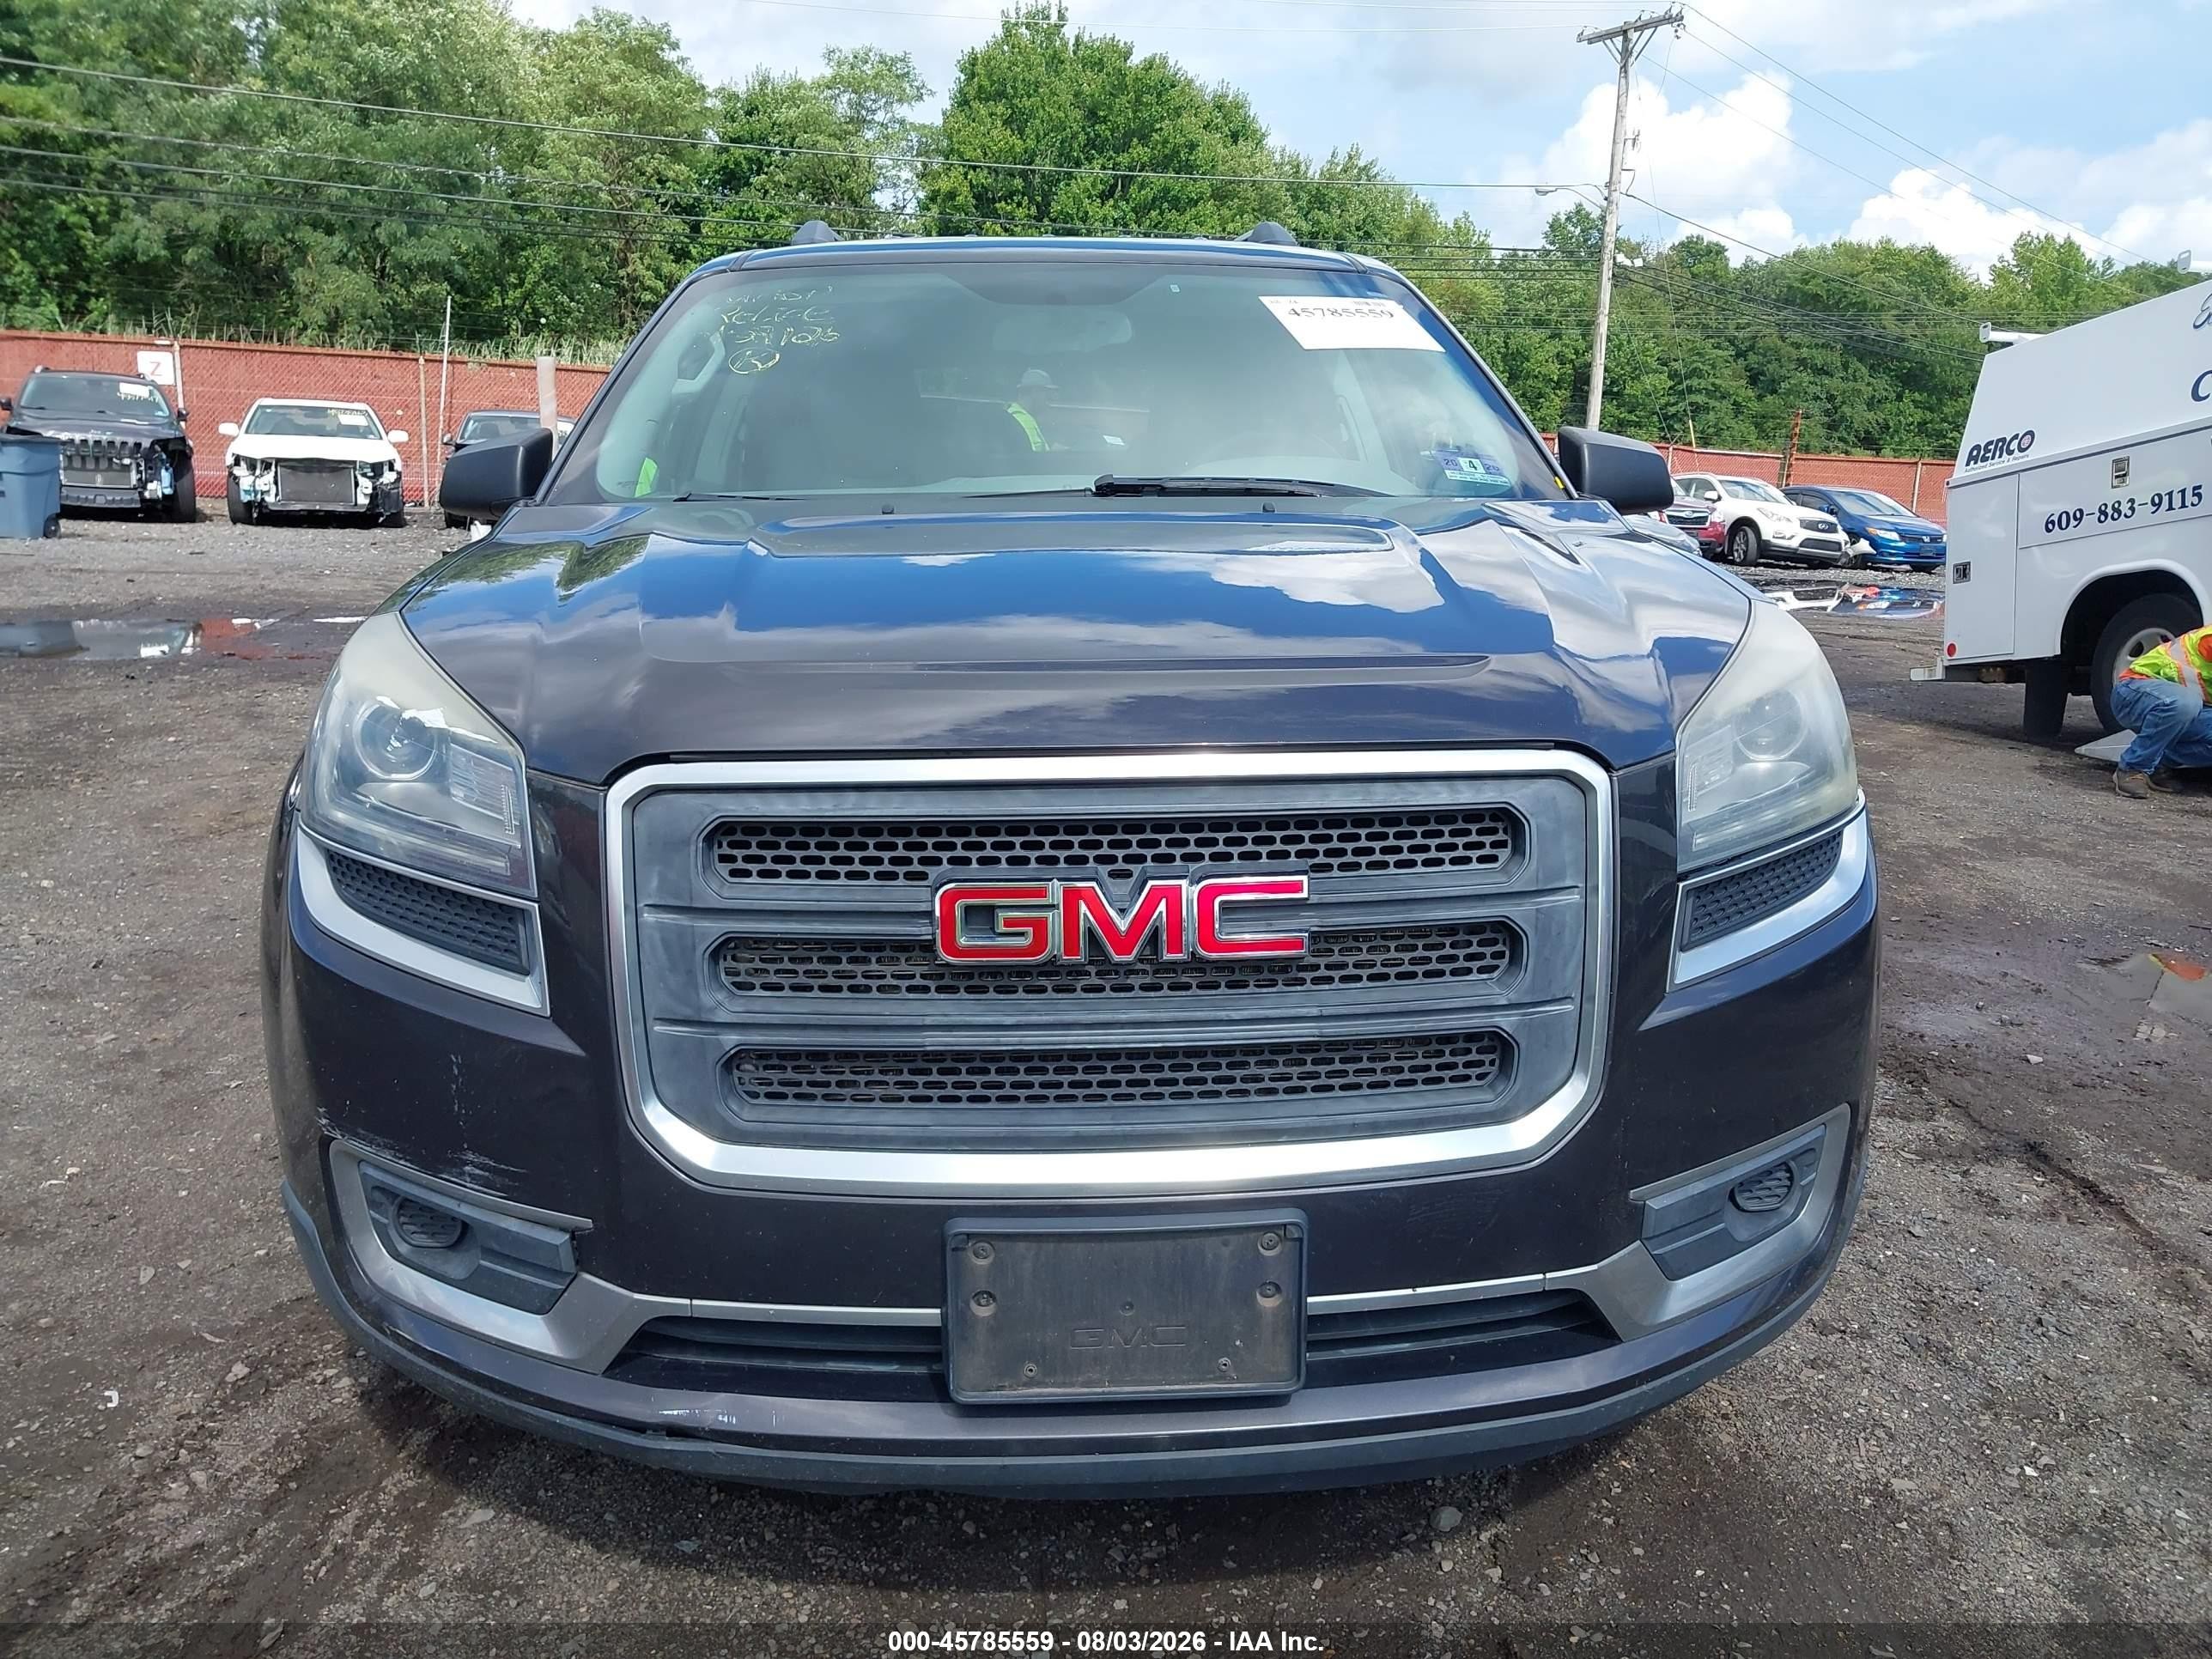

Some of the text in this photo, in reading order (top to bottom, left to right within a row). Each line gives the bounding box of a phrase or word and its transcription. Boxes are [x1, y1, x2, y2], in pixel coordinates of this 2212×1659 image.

[1288, 307, 1394, 319] 45785559
[149, 361, 163, 376] Z
[1965, 429, 2036, 467] AERCO
[1468, 460, 1478, 471] 4
[1989, 459, 2006, 468] Service
[2012, 453, 2029, 462] Repairs
[2045, 484, 2203, 533] 609-883-9115
[935, 876, 1310, 963] GMC
[1069, 1326, 1188, 1350] GMC
